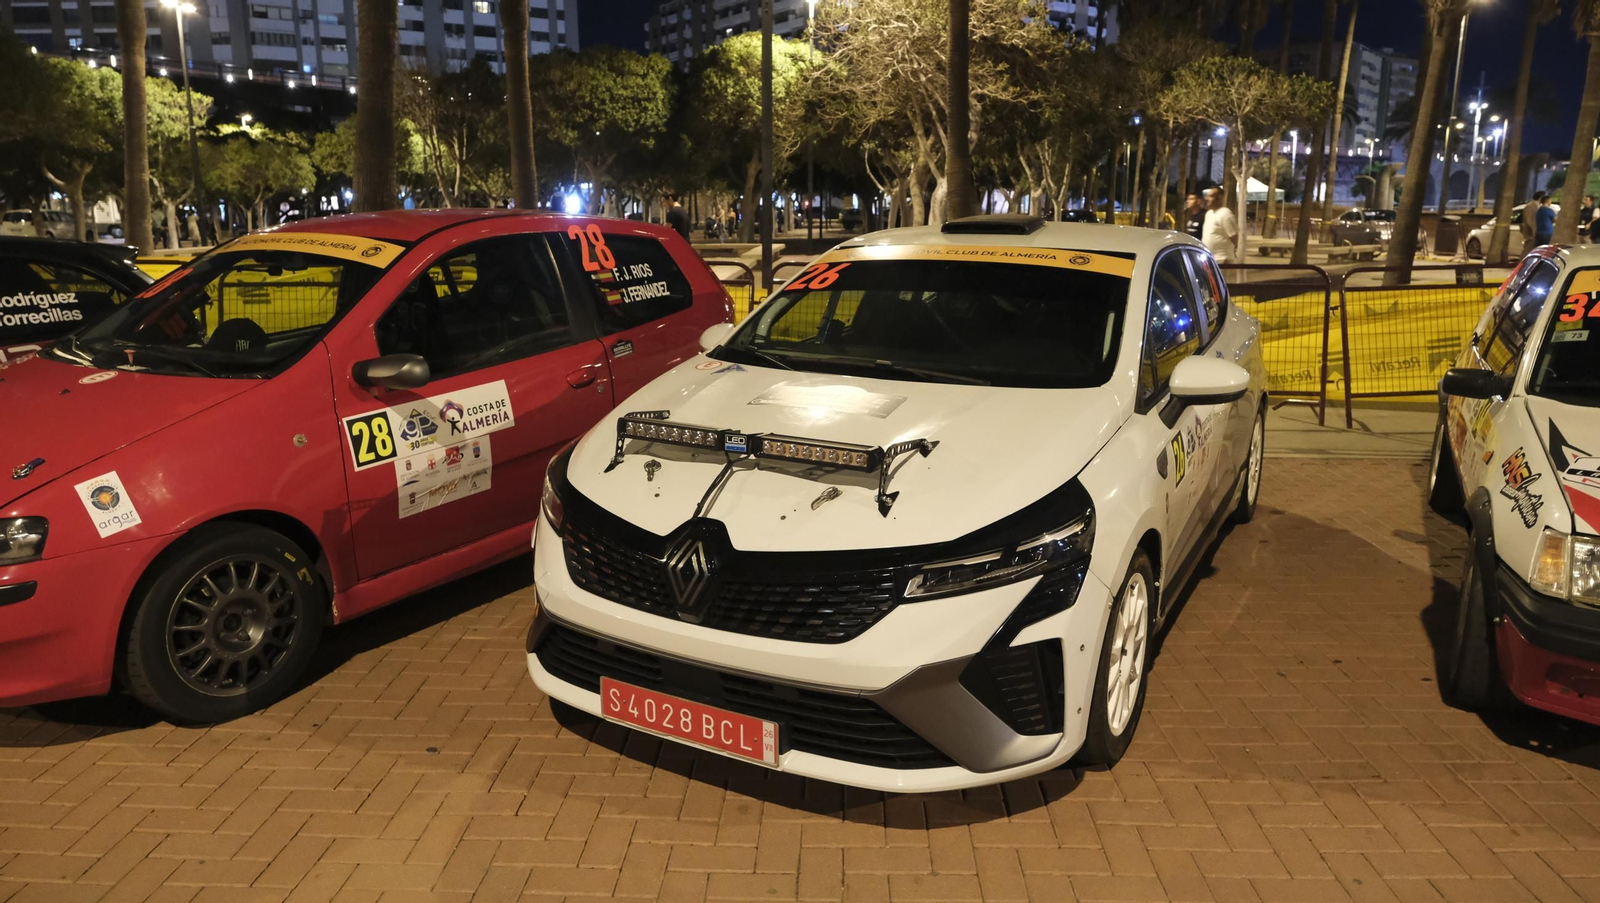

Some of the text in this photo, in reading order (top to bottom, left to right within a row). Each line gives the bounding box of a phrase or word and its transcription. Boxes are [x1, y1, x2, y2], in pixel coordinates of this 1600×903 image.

[317, 241, 357, 252] ALMERÍA
[567, 223, 616, 272] 28
[999, 252, 1057, 261] ALMERÍA
[630, 262, 653, 279] RIOS
[783, 262, 852, 291] 26
[0, 291, 79, 309] odríguez
[466, 398, 507, 416] COSTA DE
[462, 410, 511, 434] ALMERÍA
[352, 416, 394, 464] 28
[410, 439, 421, 451] 30
[98, 509, 136, 530] argar
[628, 693, 692, 734] 4028
[702, 713, 753, 752] BCL
[763, 729, 774, 739] 26
